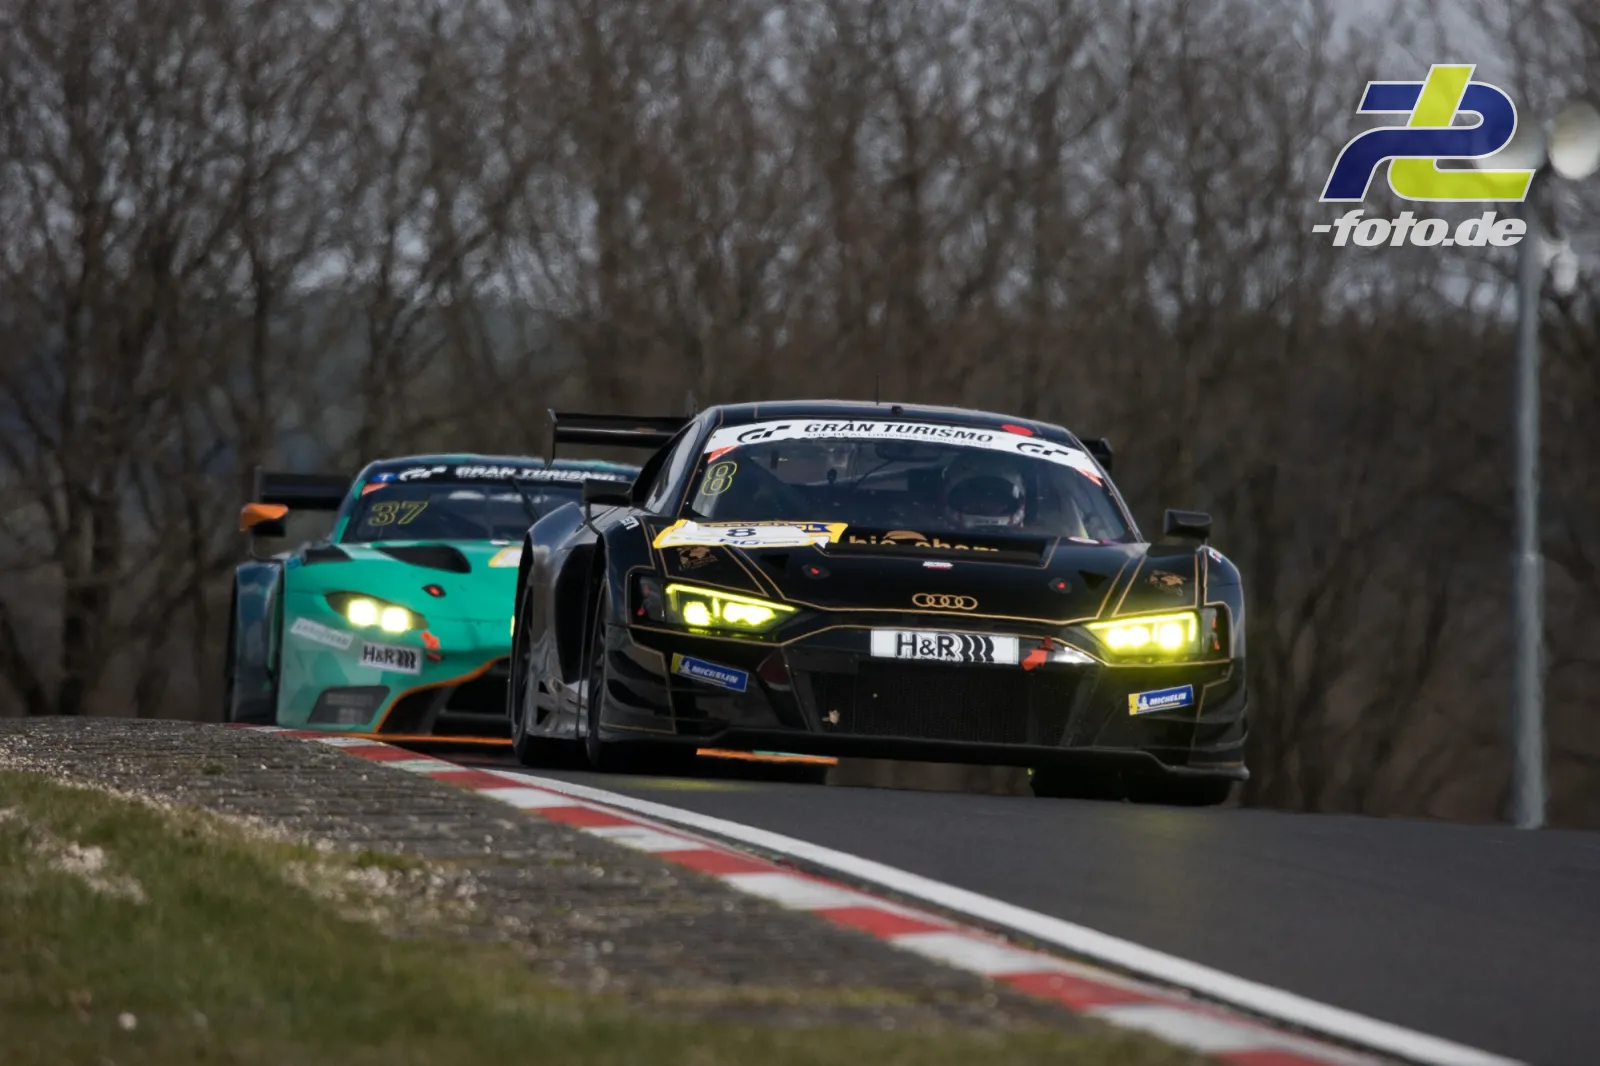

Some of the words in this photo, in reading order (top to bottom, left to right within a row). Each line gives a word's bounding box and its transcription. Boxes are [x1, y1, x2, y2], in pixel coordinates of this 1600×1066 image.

[803, 422, 875, 433] GRAN
[883, 423, 994, 443] TURISMO
[455, 466, 516, 477] GRAN
[701, 461, 738, 496] 8
[368, 501, 430, 526] 37
[726, 527, 757, 537] 8
[363, 644, 398, 665] H&R
[895, 632, 961, 661] H&R
[691, 665, 740, 684] MICHELIN
[1149, 691, 1187, 706] MICHELIN
